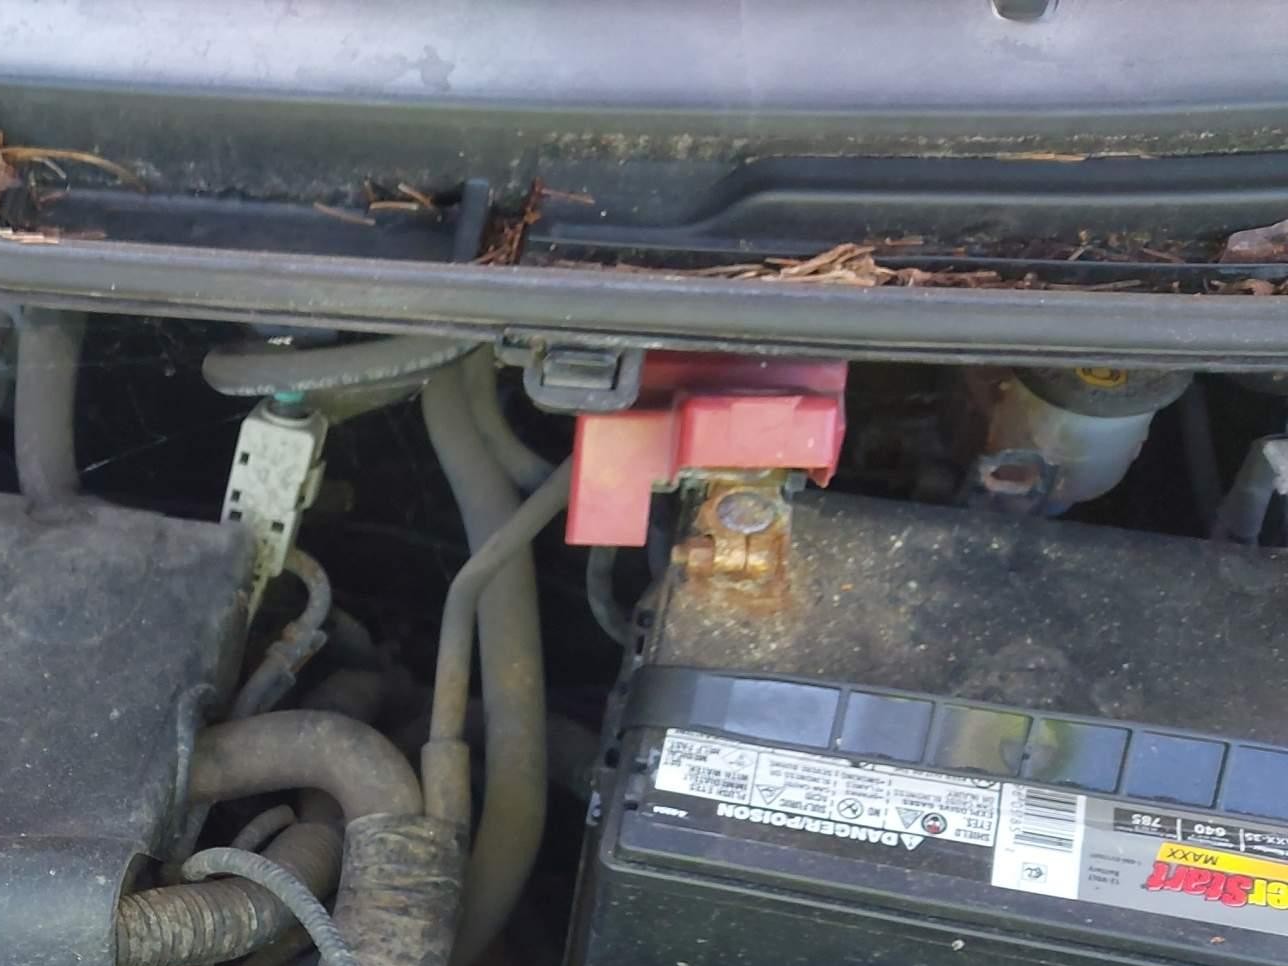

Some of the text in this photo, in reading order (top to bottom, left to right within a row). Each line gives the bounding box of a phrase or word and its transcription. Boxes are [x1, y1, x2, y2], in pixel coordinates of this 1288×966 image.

[716, 802, 898, 846] DANGER/POISON
[1130, 812, 1162, 827] 785
[1193, 823, 1226, 837] 640
[1165, 847, 1218, 865] MAXX
